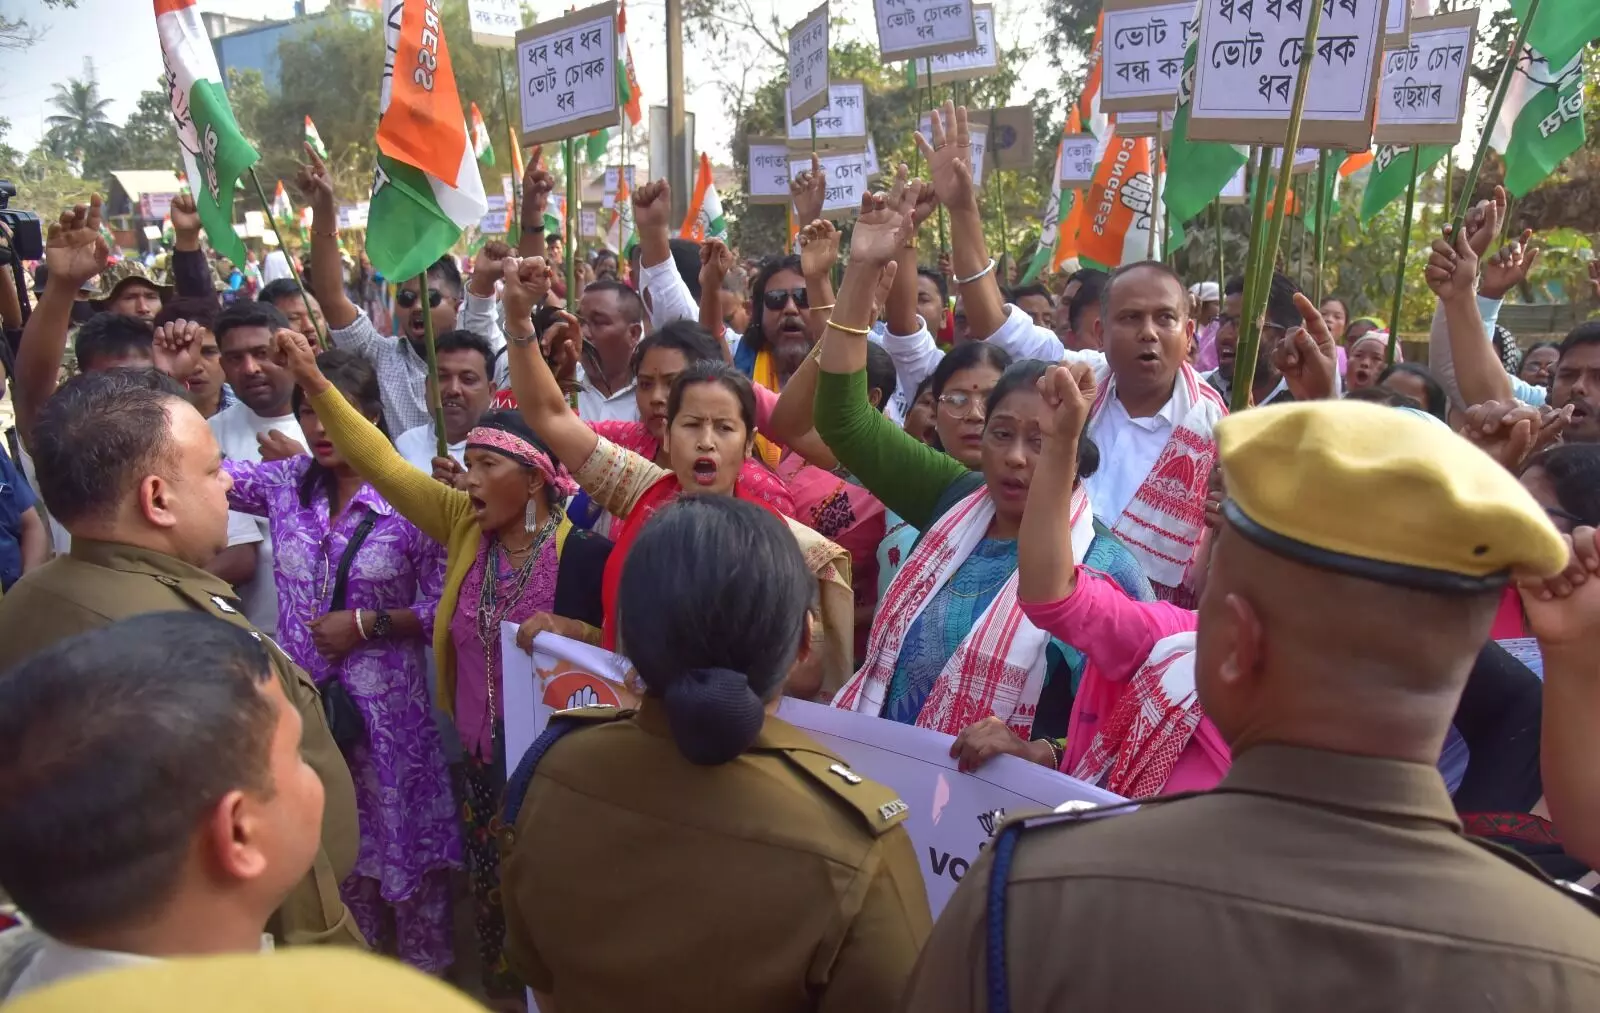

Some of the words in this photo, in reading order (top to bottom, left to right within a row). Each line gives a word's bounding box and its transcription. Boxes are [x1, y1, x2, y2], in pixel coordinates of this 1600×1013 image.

[887, 8, 915, 28] ভোট
[916, 25, 935, 39] ধৰ
[1114, 16, 1168, 50] ভোট
[528, 45, 547, 67] ধৰ
[553, 37, 574, 59] ধৰ
[580, 28, 602, 50] ধৰ
[1212, 26, 1265, 69] ভোট
[1387, 44, 1420, 74] ভোট
[1427, 44, 1464, 71] চোৰ
[528, 65, 557, 97] ভোট
[565, 57, 605, 87] চোৰক
[1114, 60, 1150, 83] বন্ধ
[557, 91, 575, 112] ধৰ
[1259, 75, 1293, 104] ধৰ
[929, 846, 969, 883] VO
